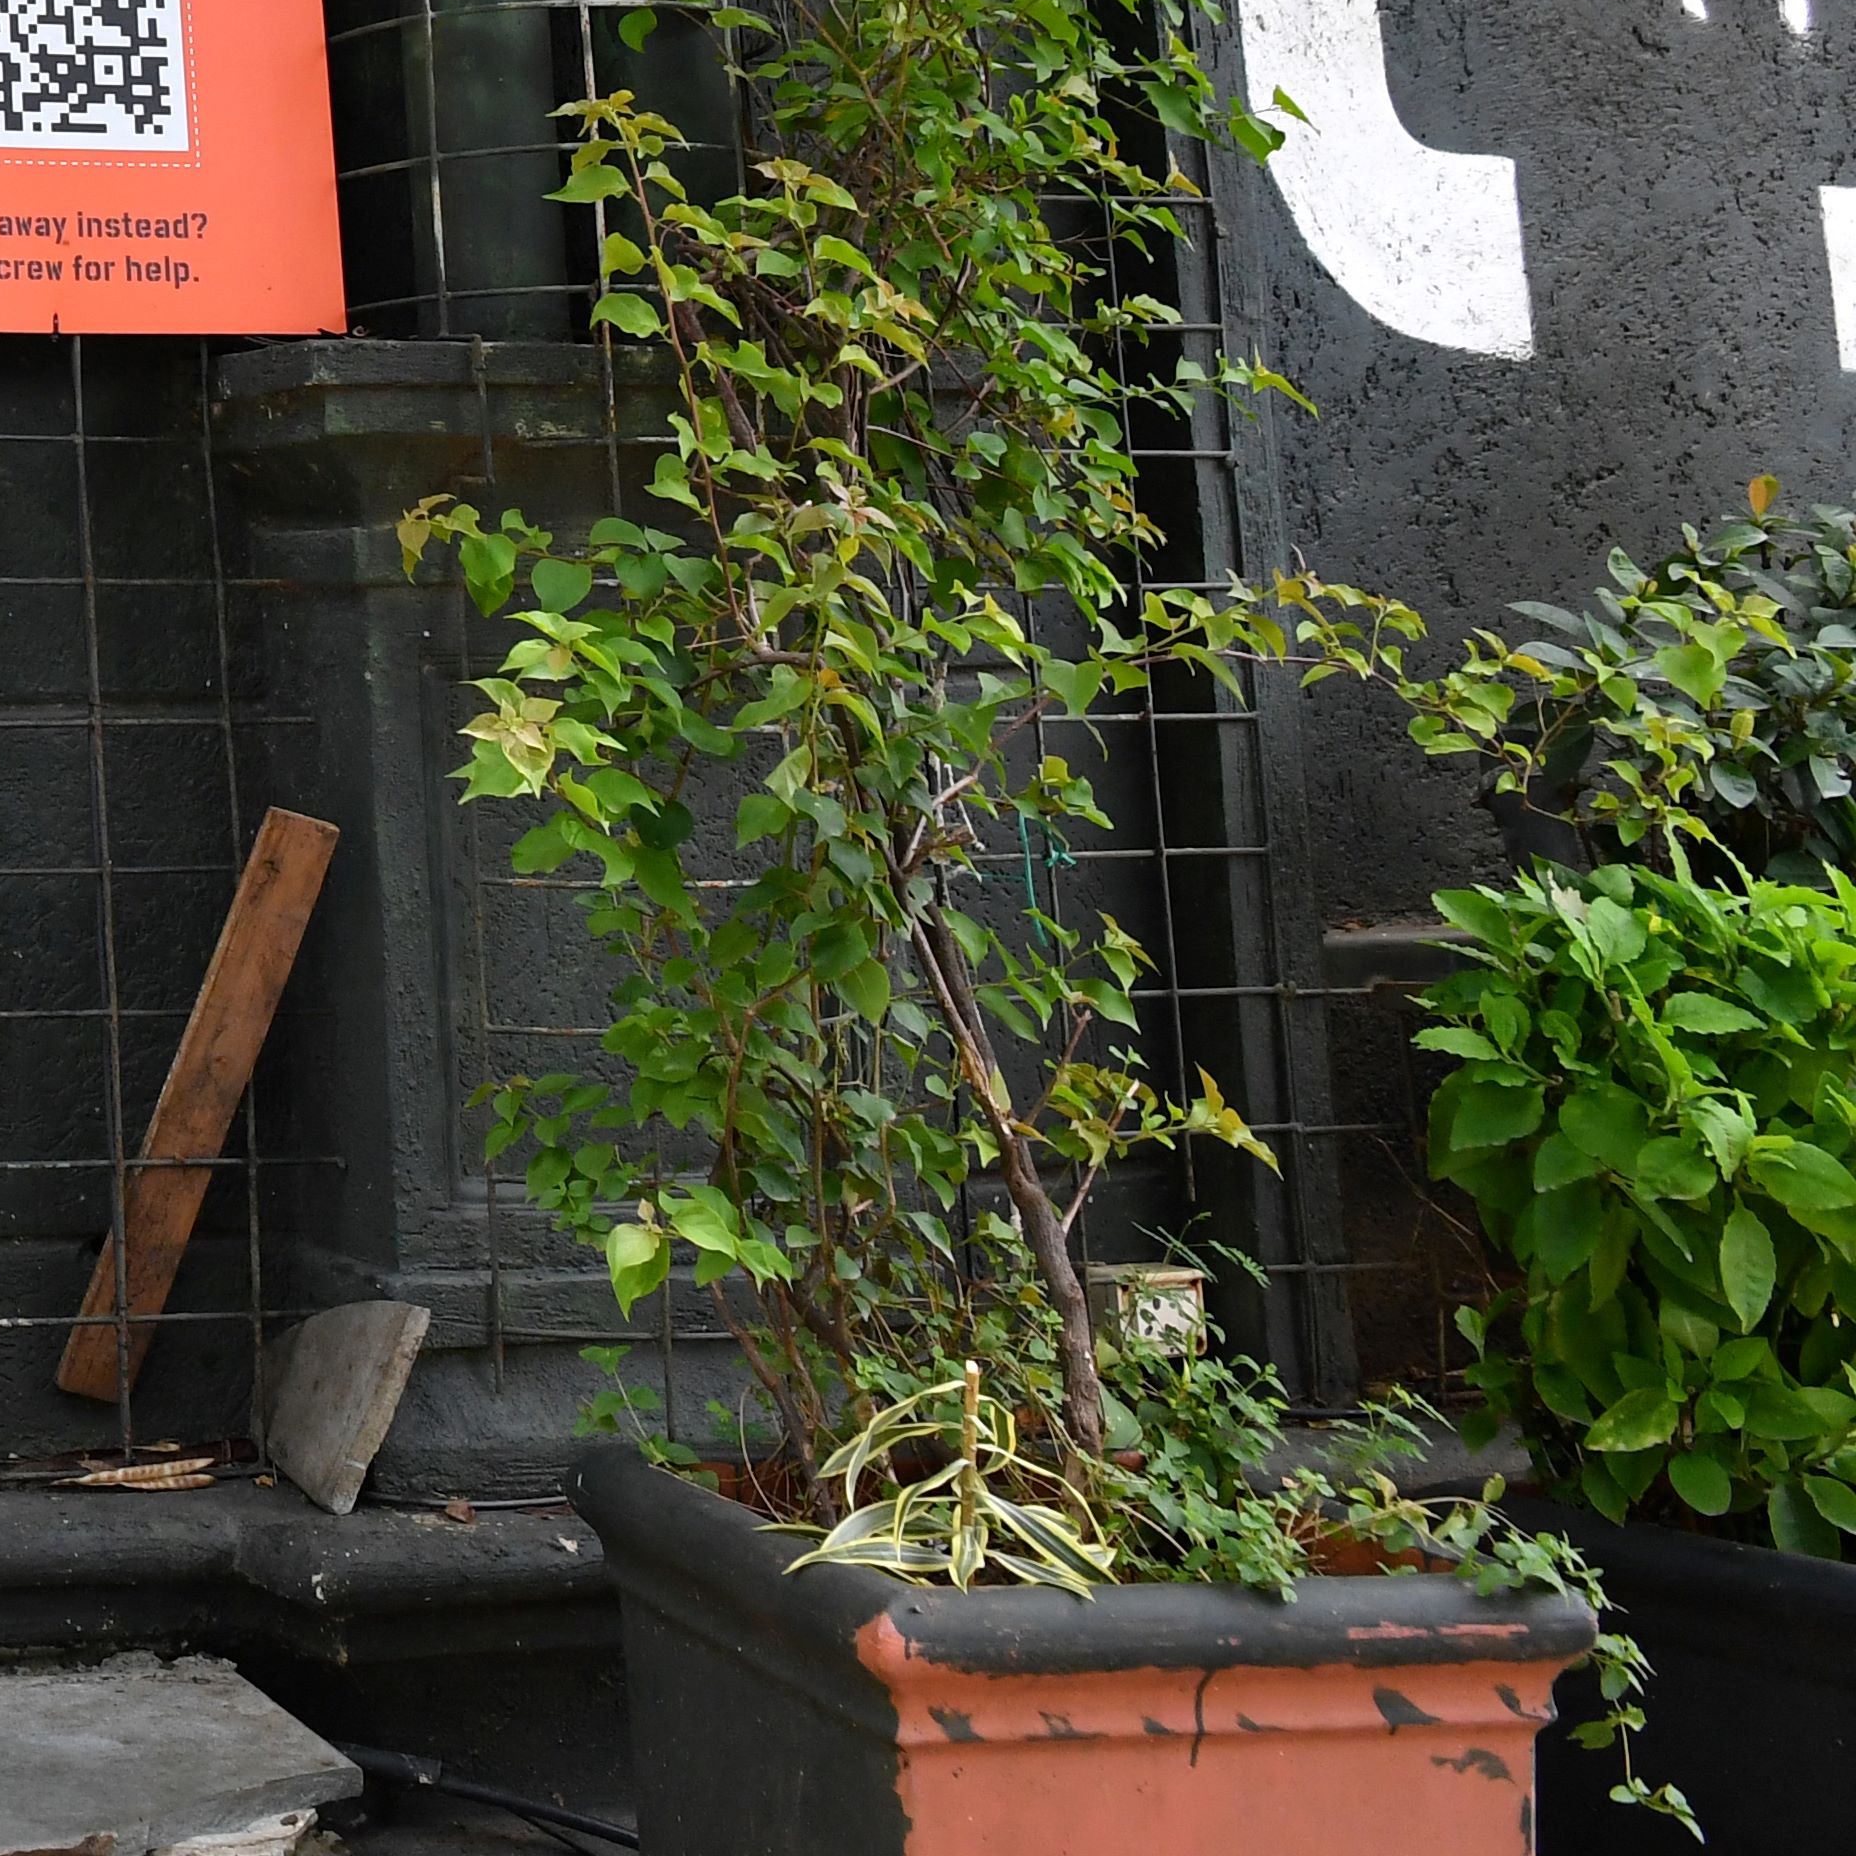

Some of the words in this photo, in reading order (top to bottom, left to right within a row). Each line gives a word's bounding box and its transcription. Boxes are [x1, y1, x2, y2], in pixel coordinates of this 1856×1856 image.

[76, 212, 207, 239] instead?
[72, 255, 115, 282] for
[124, 255, 199, 289] help.
